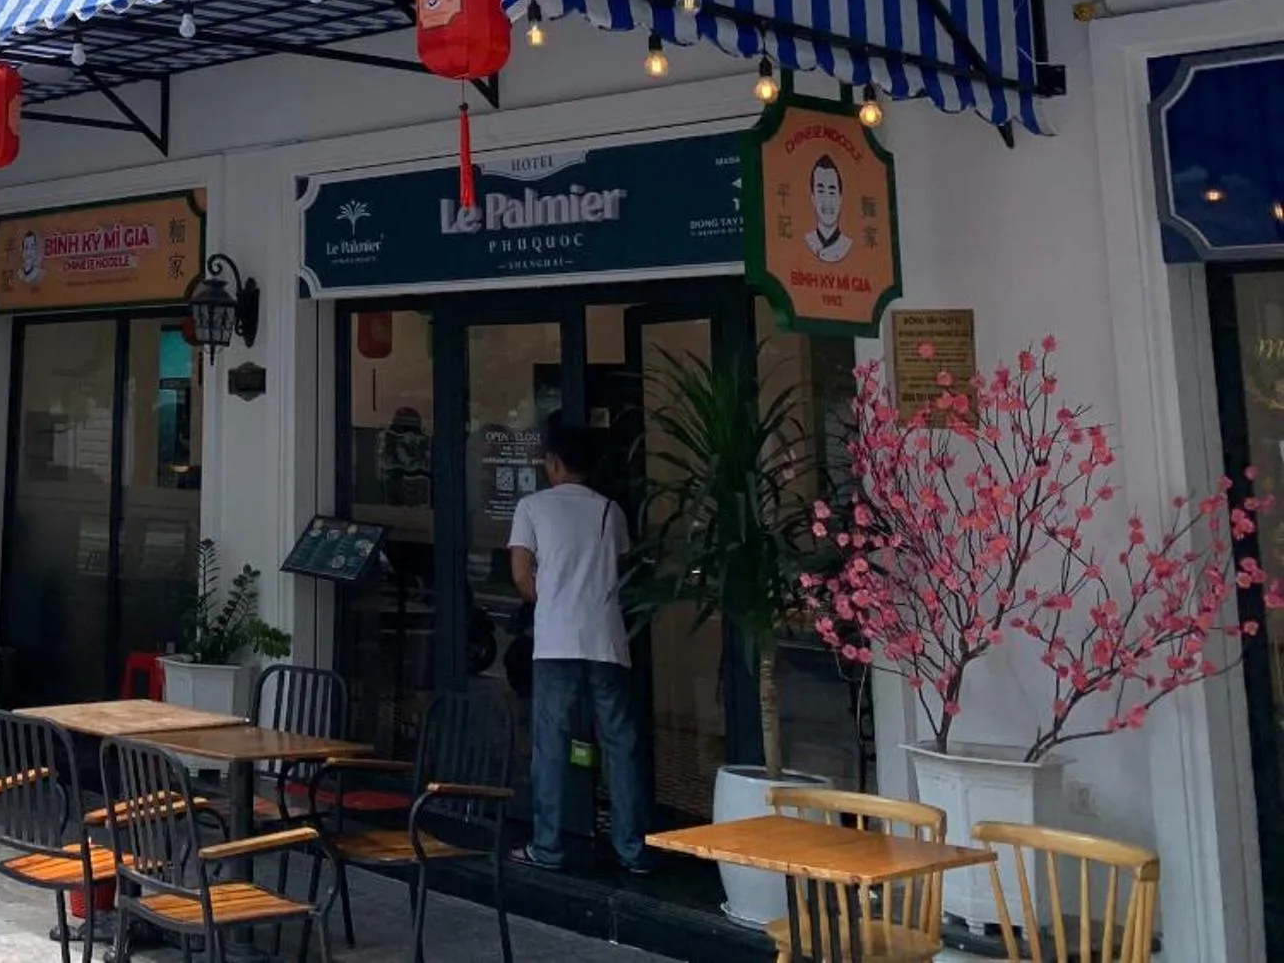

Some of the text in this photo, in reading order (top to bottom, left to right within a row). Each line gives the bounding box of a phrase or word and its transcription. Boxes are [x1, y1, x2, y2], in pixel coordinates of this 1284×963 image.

[511, 154, 554, 172] HOTEL
[440, 184, 628, 235] Le Palmier
[44, 232, 78, 256] BÌNH
[104, 225, 120, 250] MÌ
[124, 227, 149, 248] GIA
[326, 238, 381, 256] Le Palmier
